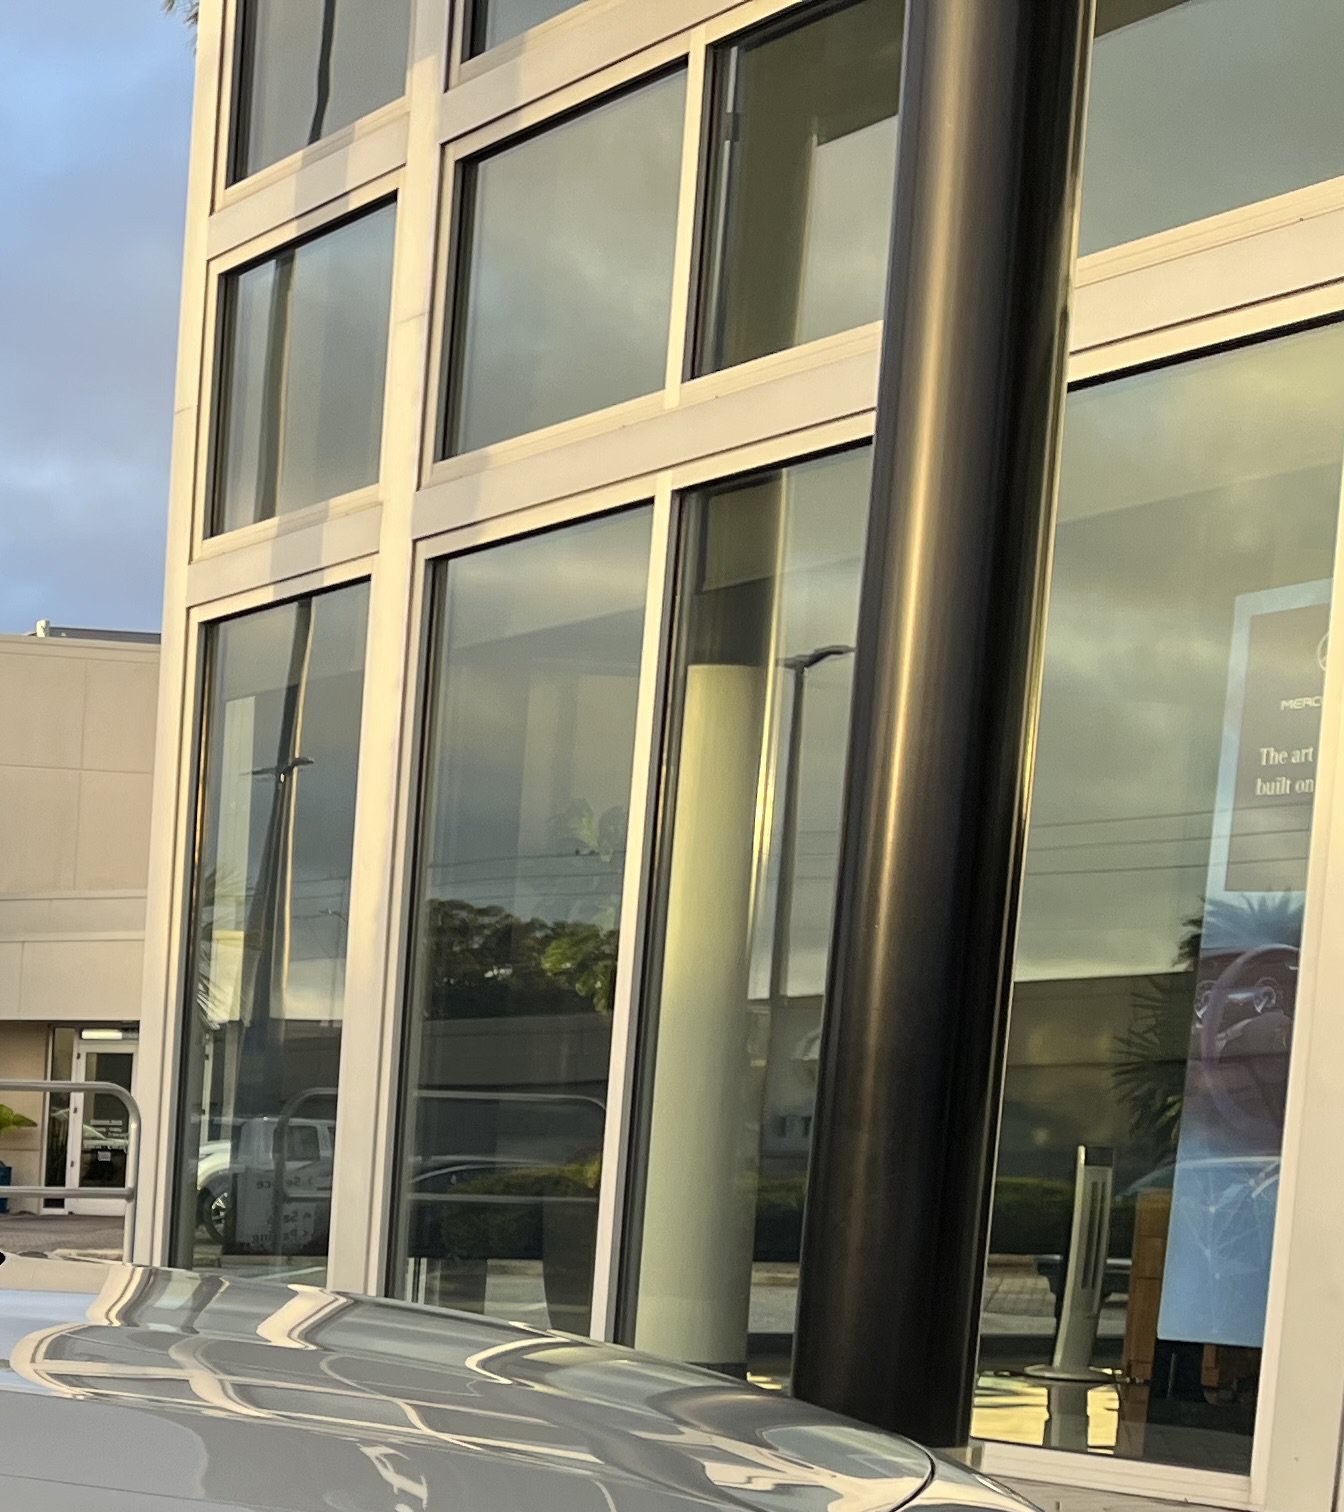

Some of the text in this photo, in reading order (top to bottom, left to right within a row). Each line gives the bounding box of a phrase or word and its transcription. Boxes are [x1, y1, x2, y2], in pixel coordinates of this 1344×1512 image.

[1259, 746, 1314, 766] The art
[1256, 776, 1314, 796] built on
